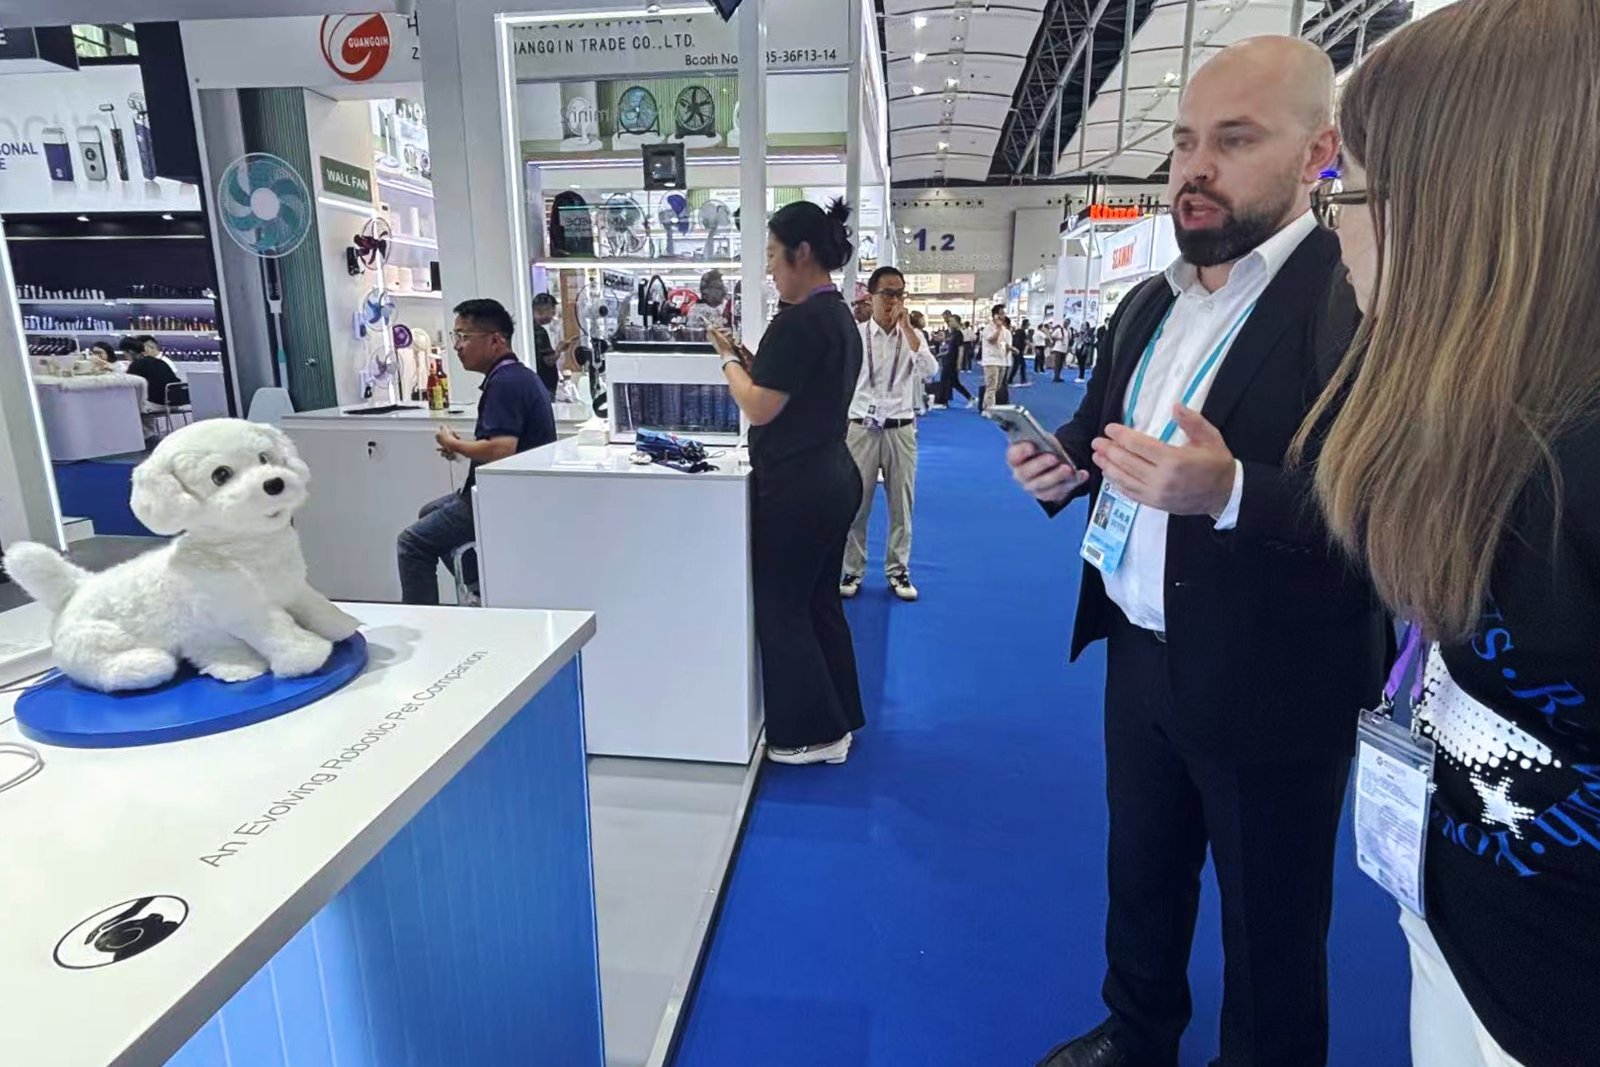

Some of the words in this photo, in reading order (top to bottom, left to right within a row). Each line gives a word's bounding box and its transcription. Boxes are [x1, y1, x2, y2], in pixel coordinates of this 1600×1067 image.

[347, 35, 389, 48] GUANGQIN
[580, 37, 626, 53] TRADE
[685, 53, 718, 65] Booth
[0, 142, 38, 156] ONAL
[326, 168, 351, 187] WALL
[351, 176, 368, 191] FAN
[913, 228, 955, 251] 1.2
[199, 841, 248, 868] An
[233, 773, 338, 836] Evolving
[320, 721, 397, 769] Robotic
[384, 702, 425, 720] Pet
[412, 651, 488, 701] Companion
